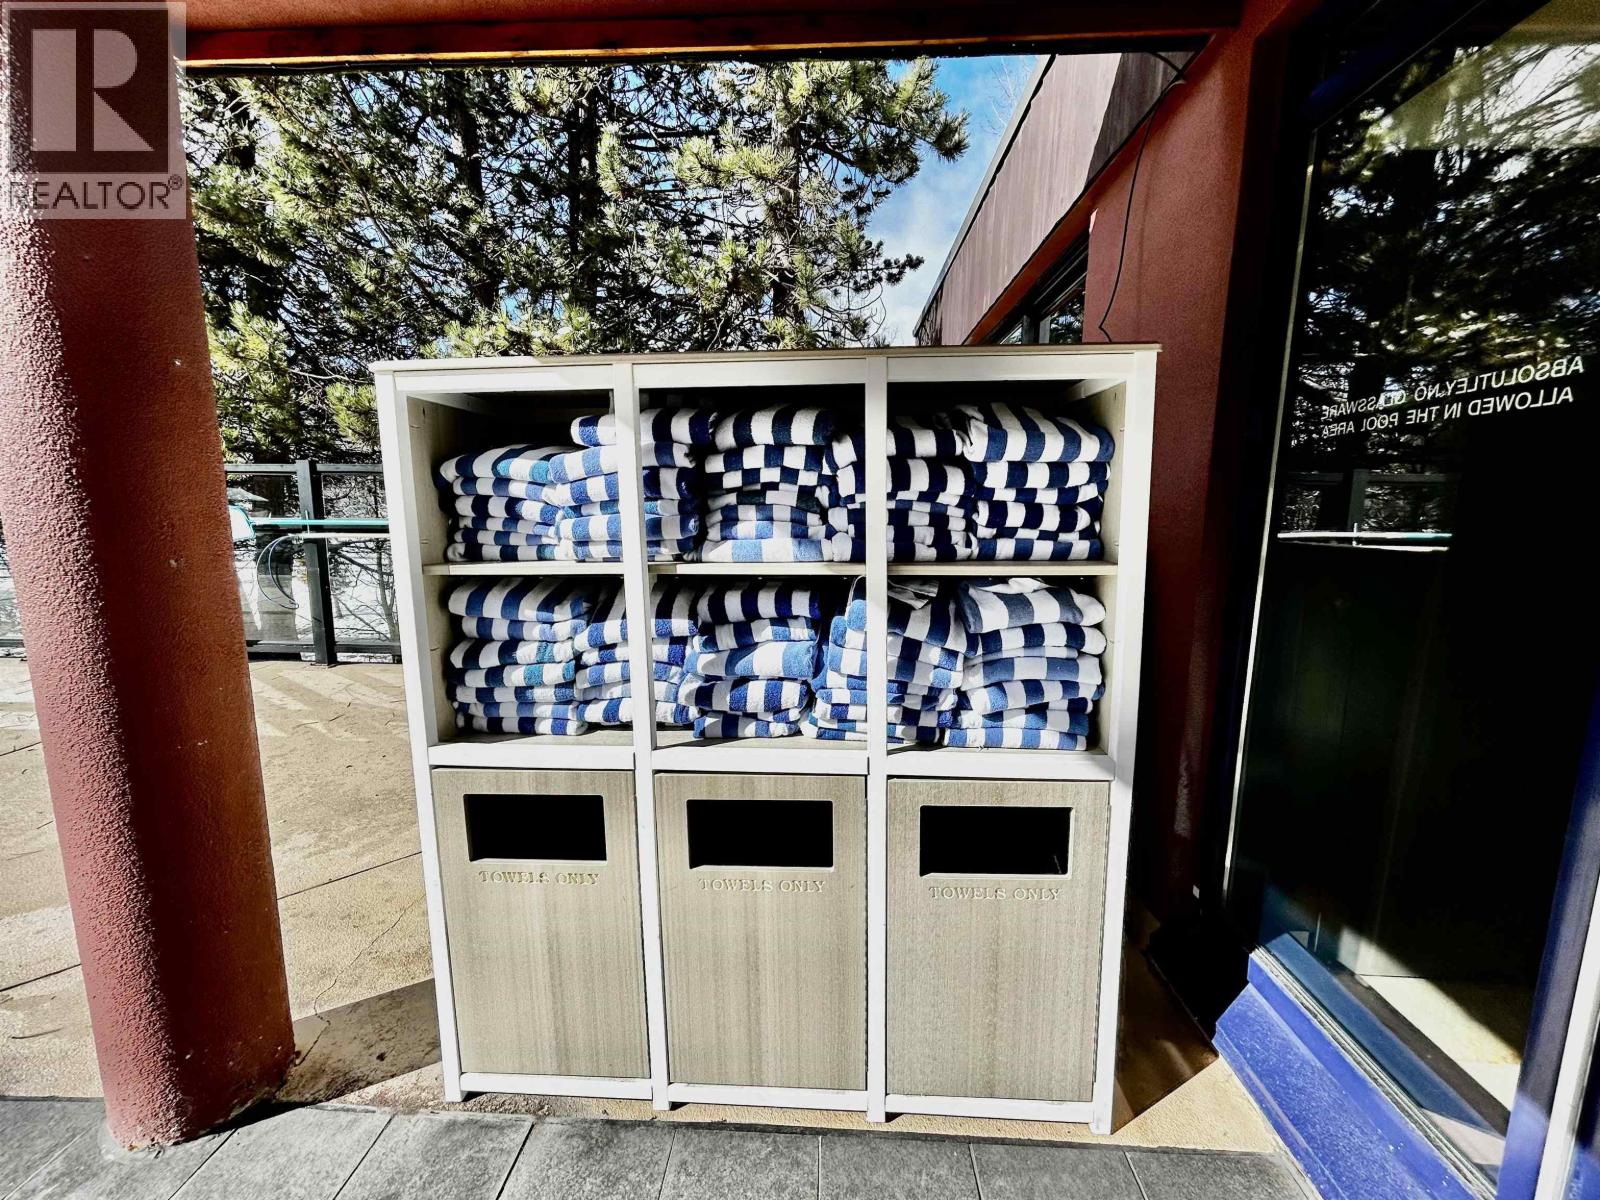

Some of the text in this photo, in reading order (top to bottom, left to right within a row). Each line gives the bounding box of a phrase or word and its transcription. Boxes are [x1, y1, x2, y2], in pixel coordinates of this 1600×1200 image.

[478, 870, 600, 885] TOWELS ONLY
[698, 878, 825, 893] TOWELS ONLY
[928, 886, 1061, 901] TOWELS ONLY
